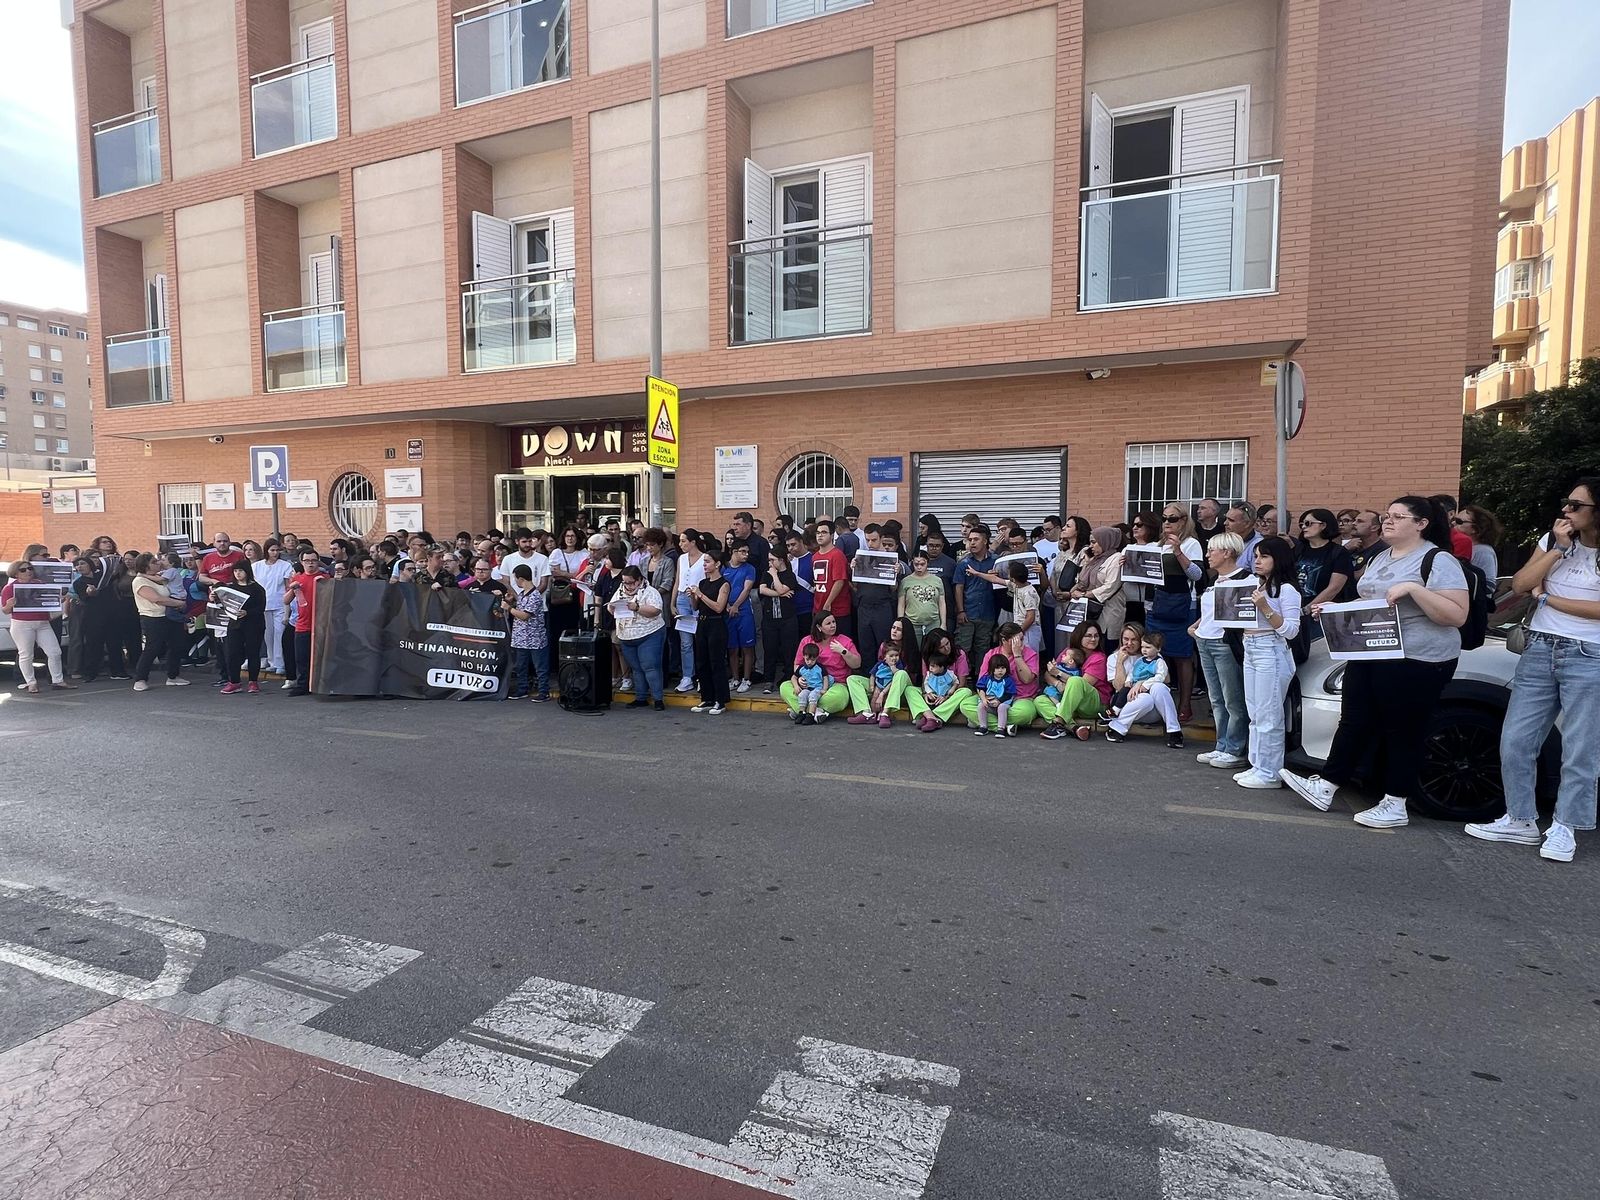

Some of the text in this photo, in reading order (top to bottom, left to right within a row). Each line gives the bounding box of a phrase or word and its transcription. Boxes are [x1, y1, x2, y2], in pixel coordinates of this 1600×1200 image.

[640, 445, 648, 453] D
[657, 445, 671, 455] ZONA
[653, 453, 676, 465] ESCOLAR
[257, 451, 280, 488] P
[399, 640, 499, 661] SIN FINANCIACIÓN,
[460, 661, 498, 673] NO HAY
[434, 672, 494, 690] FUTURO
